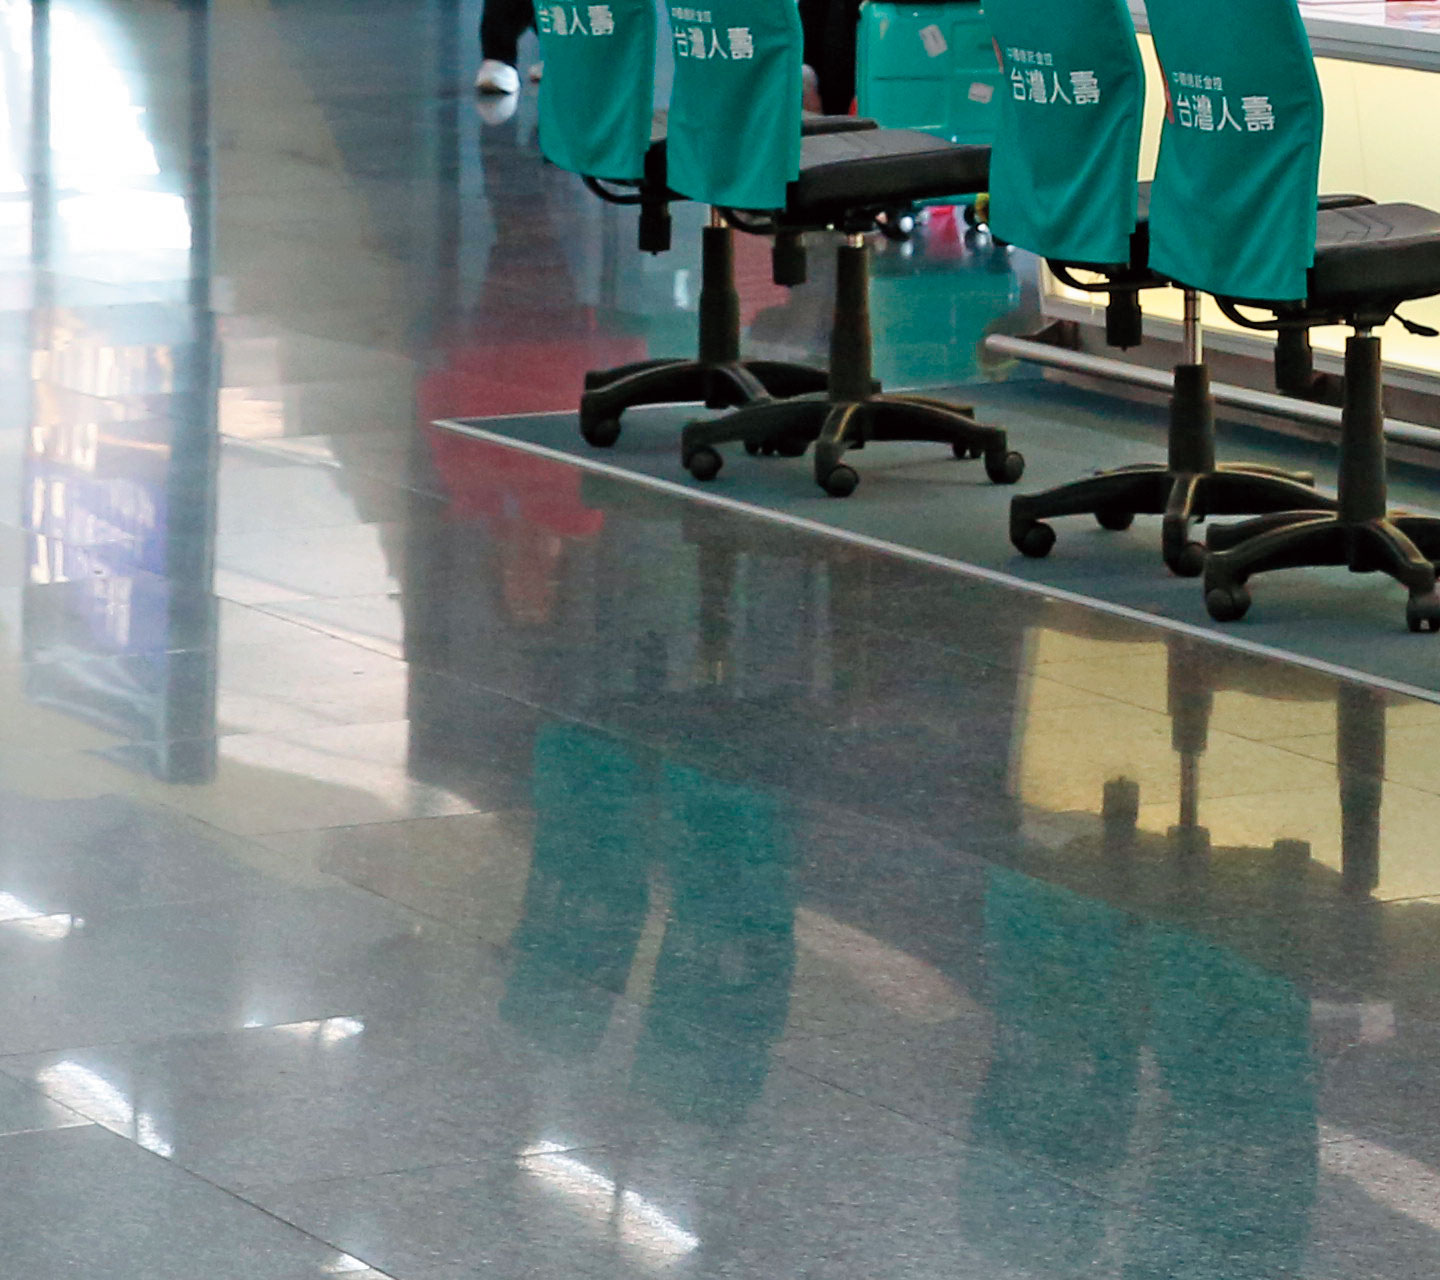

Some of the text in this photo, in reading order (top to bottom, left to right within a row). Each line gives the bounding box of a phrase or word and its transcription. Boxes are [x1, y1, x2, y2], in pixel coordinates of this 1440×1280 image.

[1010, 67, 1101, 105] 台灣人壽
[1176, 93, 1276, 132] 台灣人壽
